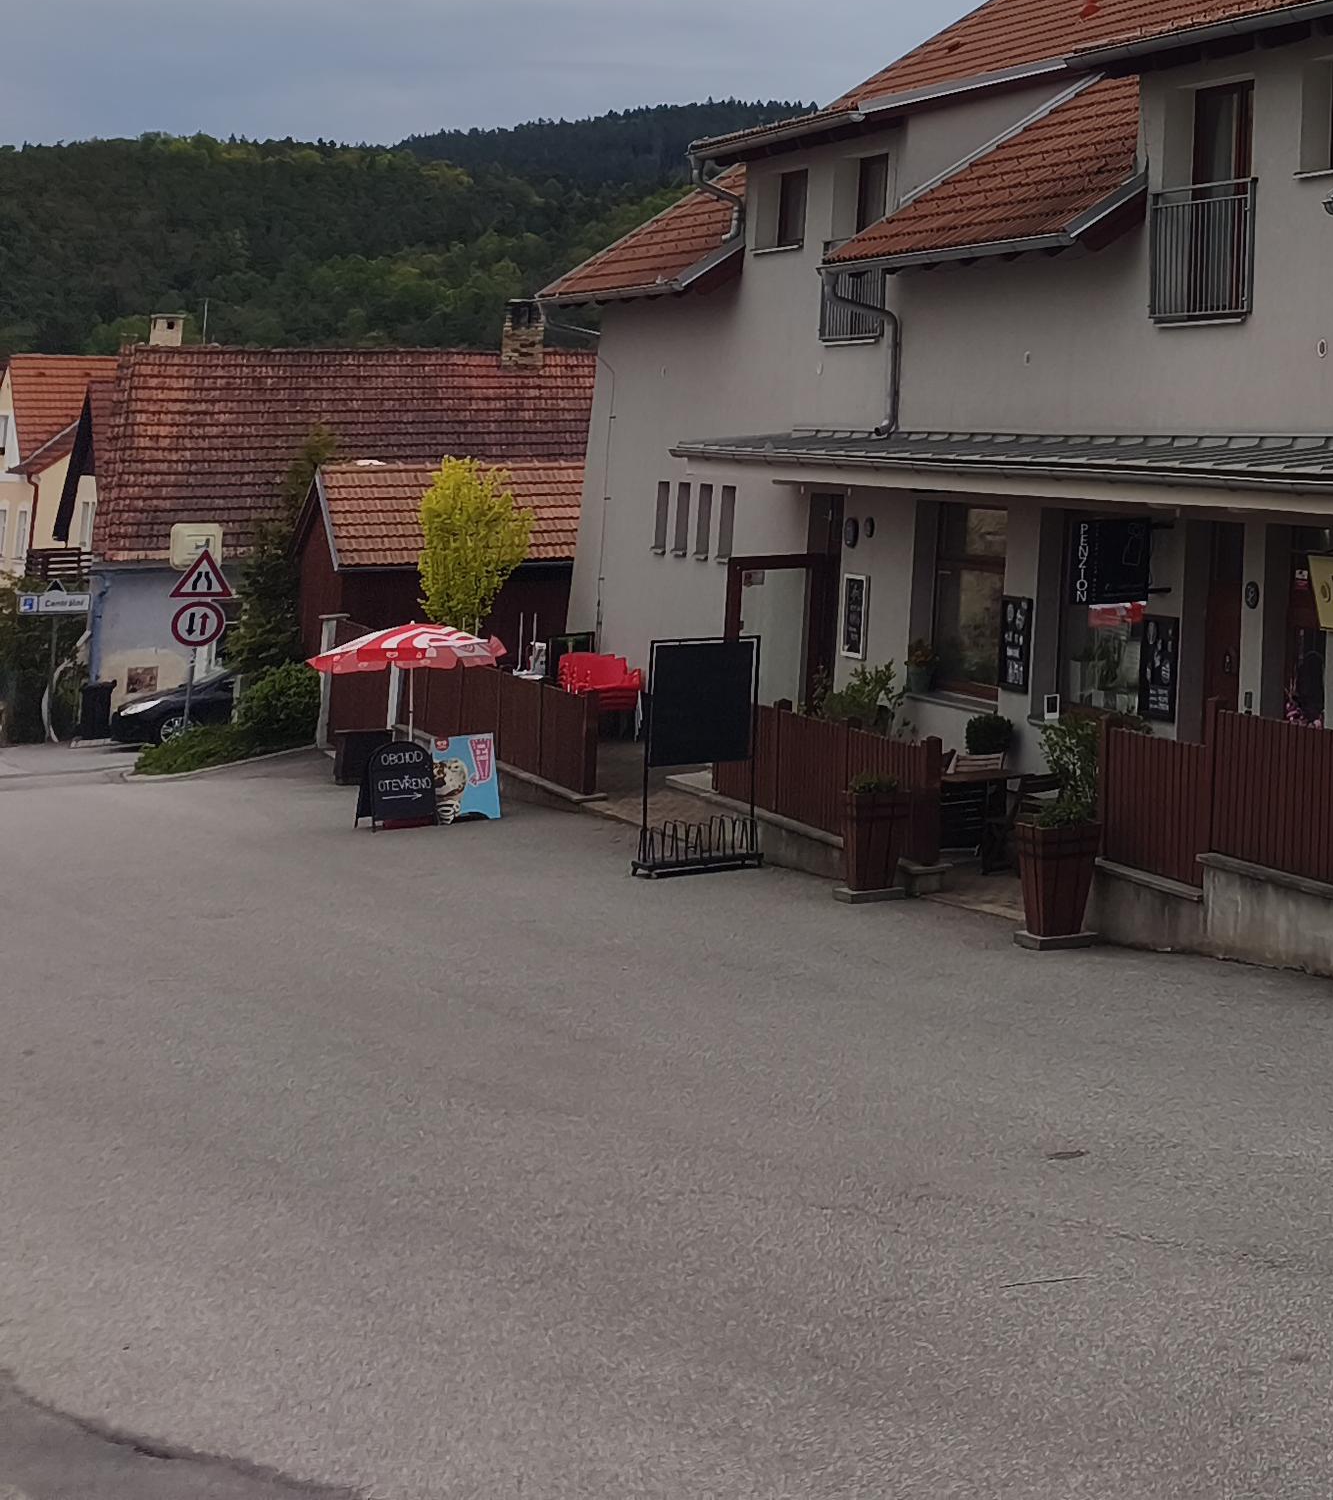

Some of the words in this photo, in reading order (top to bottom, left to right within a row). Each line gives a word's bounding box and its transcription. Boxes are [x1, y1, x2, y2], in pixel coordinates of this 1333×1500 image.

[1076, 523, 1089, 603] PENZION
[381, 750, 424, 766] OBCHOD
[378, 774, 432, 792] OTEVŘENO
